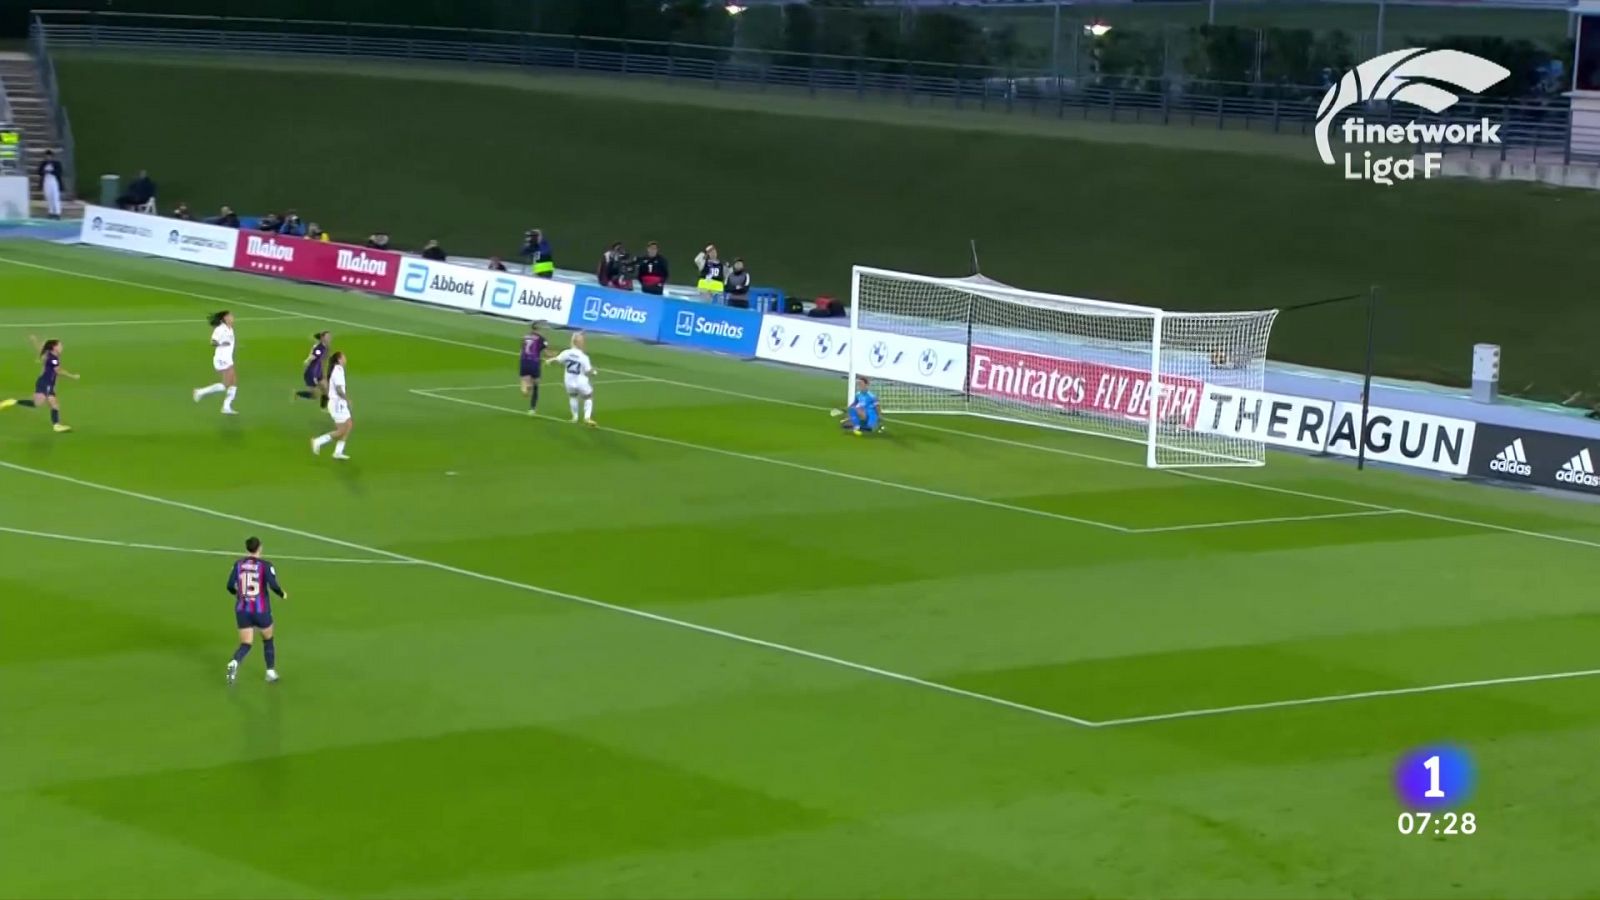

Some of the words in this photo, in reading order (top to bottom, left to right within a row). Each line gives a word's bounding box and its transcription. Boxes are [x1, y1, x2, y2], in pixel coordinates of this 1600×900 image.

[246, 236, 294, 262] Mahou
[336, 249, 387, 276] Mahou
[429, 274, 475, 296] Abbott
[517, 289, 563, 311] Abbott
[600, 302, 648, 324] Sanitas
[694, 316, 744, 339] Sanitas
[970, 354, 1086, 405] Emirates
[1093, 373, 1129, 410] FLY
[1127, 379, 1198, 423] BETER
[1209, 392, 1465, 465] THERAGUN
[1489, 458, 1532, 477] adidas
[1555, 469, 1599, 487] adidas
[239, 572, 260, 596] 15
